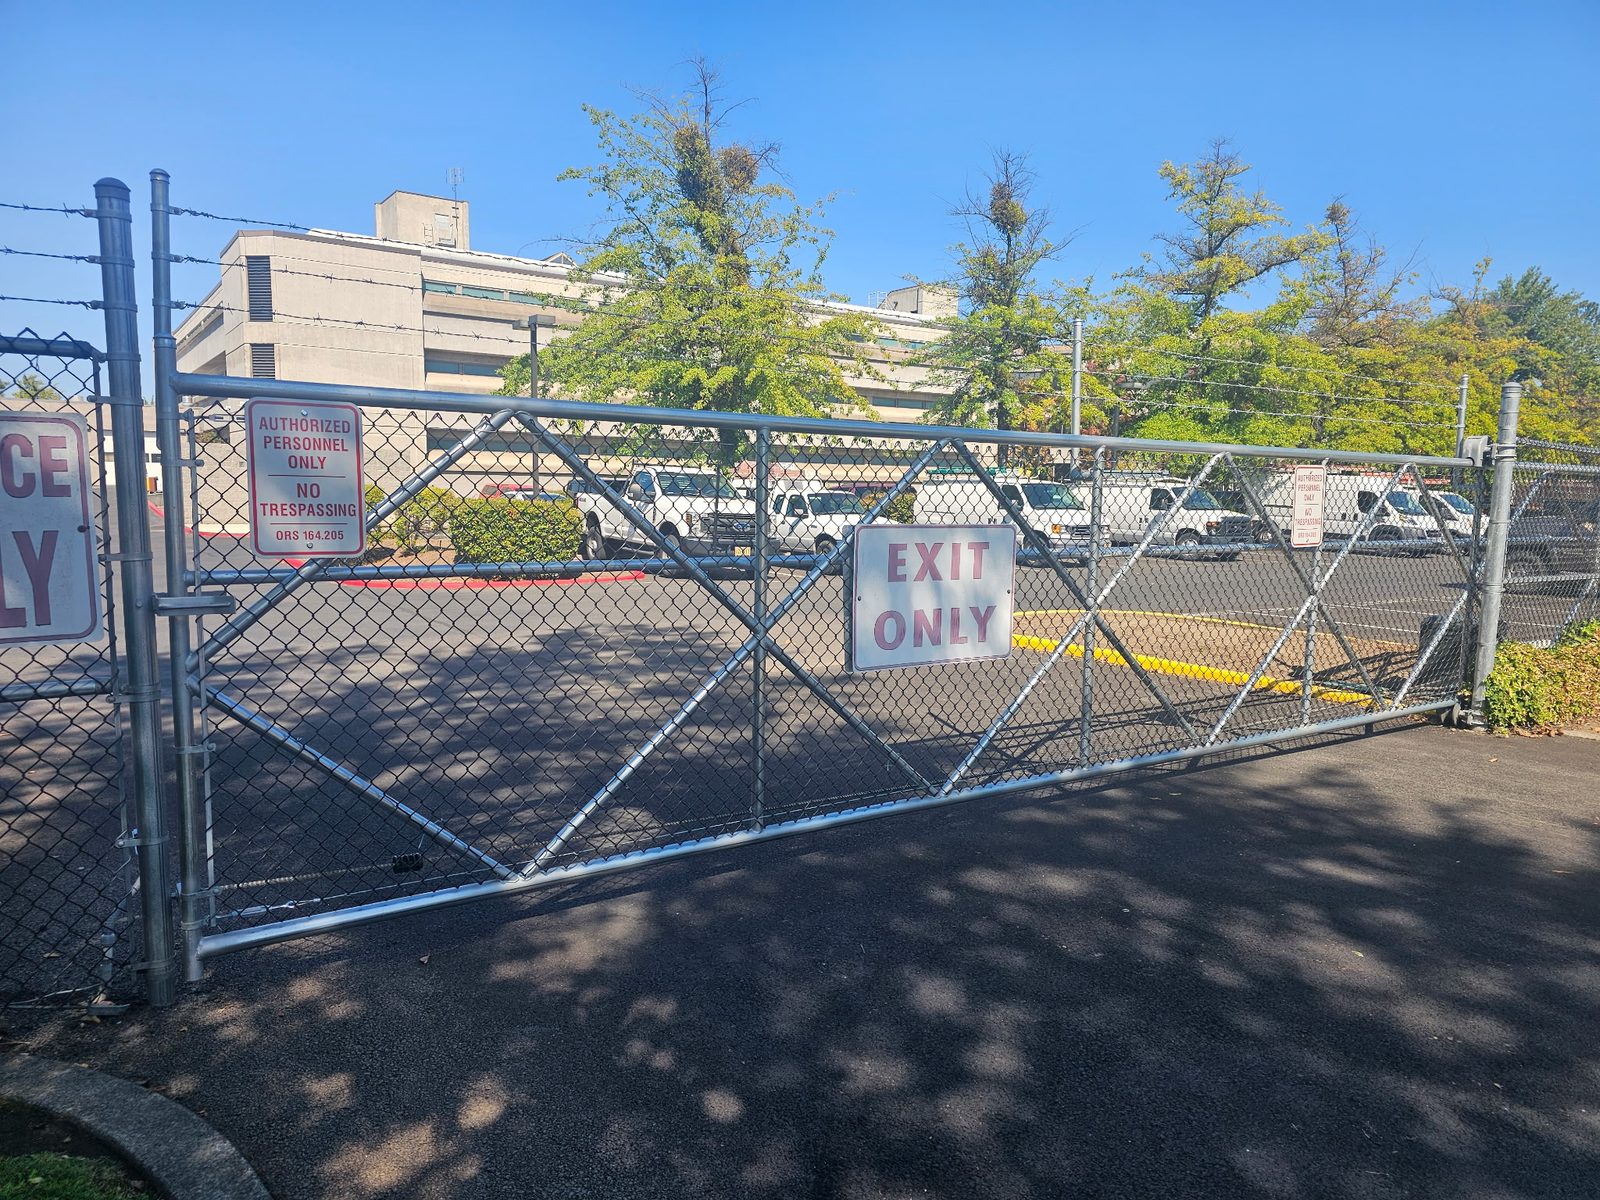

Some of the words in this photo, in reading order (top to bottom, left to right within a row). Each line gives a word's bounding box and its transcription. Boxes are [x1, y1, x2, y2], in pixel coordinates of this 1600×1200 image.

[259, 417, 350, 433] AUTHORIZED
[263, 435, 348, 451] PERSONNEL
[288, 455, 327, 469] ONLY
[297, 483, 320, 498] NO
[260, 503, 356, 517] TRESPASSING
[276, 530, 299, 541] ORS
[303, 530, 344, 541] 164.205
[888, 541, 990, 582] EXIT
[873, 605, 997, 651] ONLY
